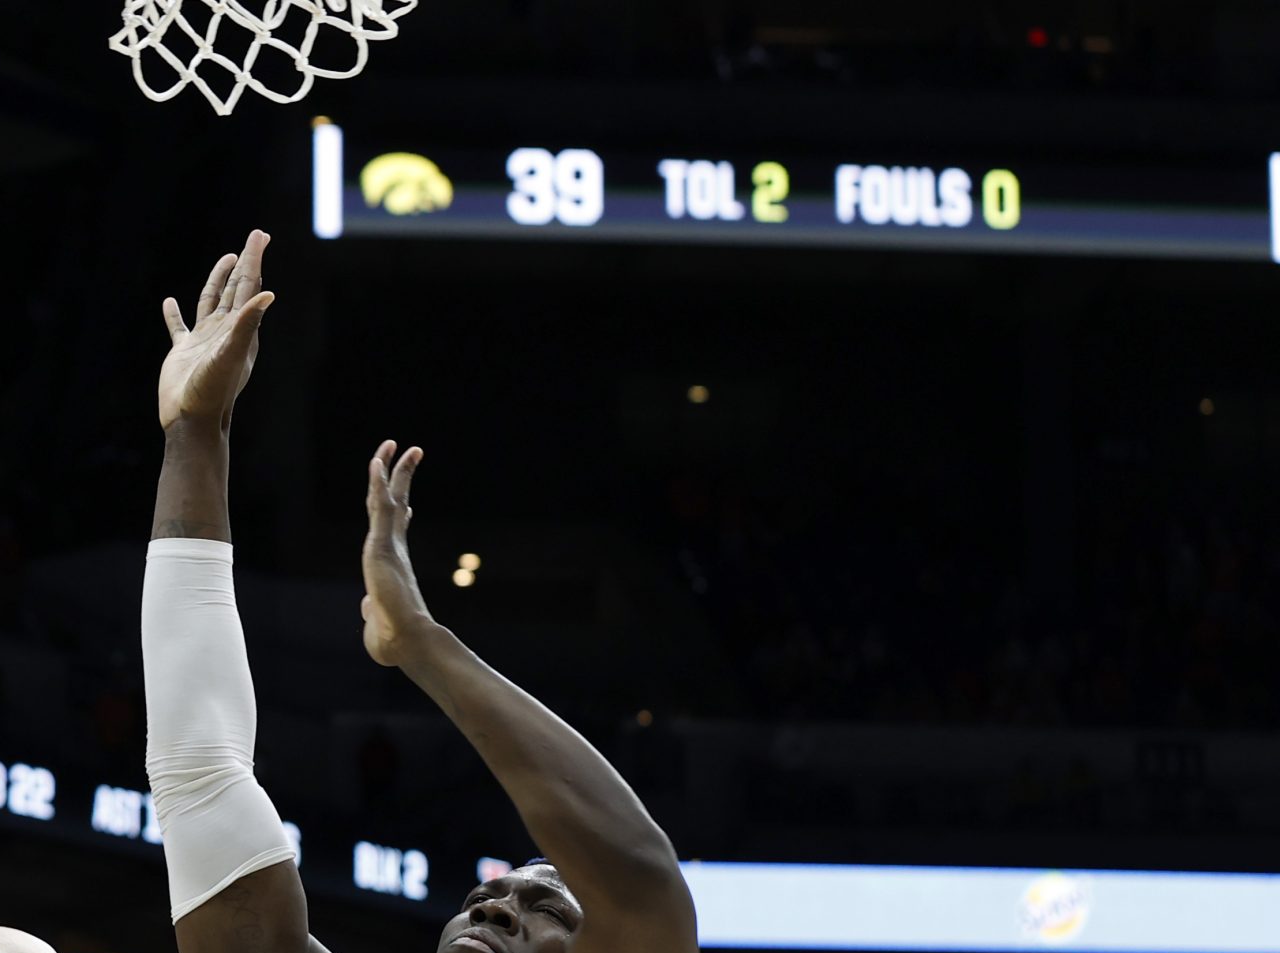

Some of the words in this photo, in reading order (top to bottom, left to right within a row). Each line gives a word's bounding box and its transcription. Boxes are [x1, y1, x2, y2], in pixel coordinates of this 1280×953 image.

[507, 147, 604, 226] 39
[659, 159, 745, 221] TOL
[752, 161, 789, 223] 2
[834, 164, 972, 227] FOULS
[981, 169, 1021, 229] 0
[8, 762, 56, 821] 22
[402, 849, 429, 900] 2
